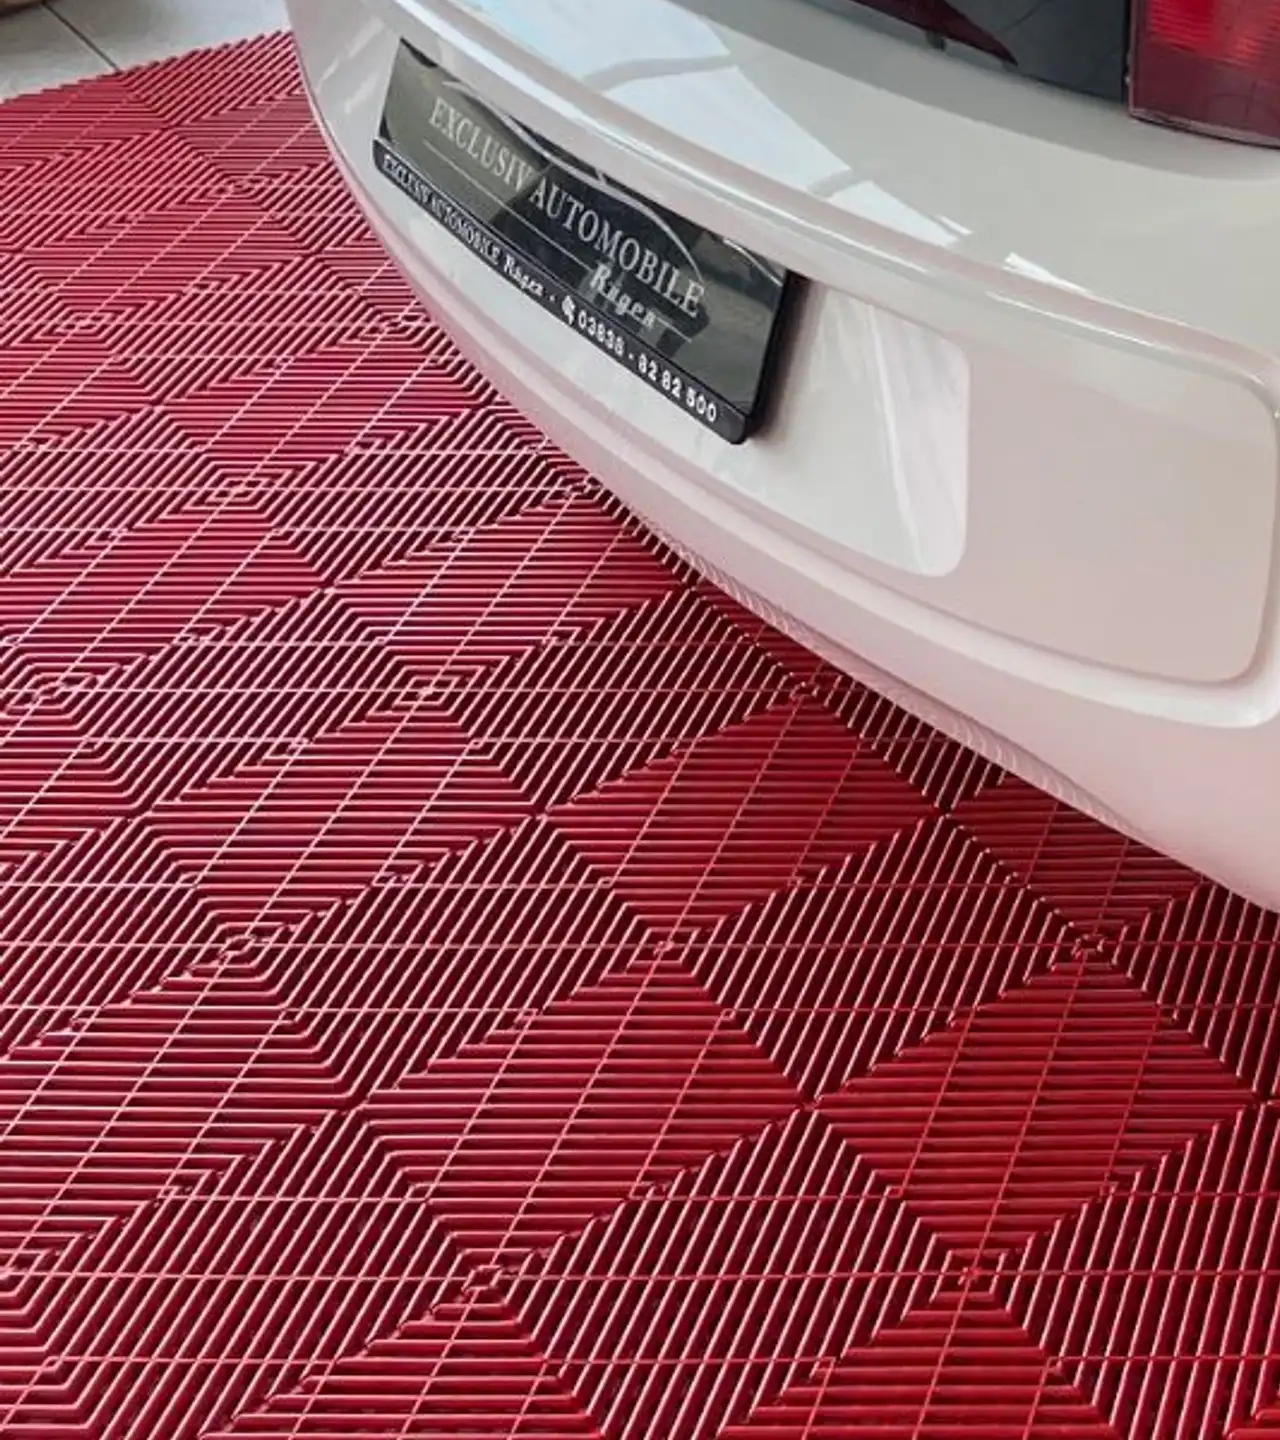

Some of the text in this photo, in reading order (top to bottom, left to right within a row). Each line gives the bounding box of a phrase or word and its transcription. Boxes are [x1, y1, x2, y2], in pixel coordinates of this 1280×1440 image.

[429, 96, 705, 318] EXCLUSIV AUTOMOBILE
[638, 353, 658, 381] 82
[662, 370, 682, 398] 82
[686, 386, 717, 422] 500
